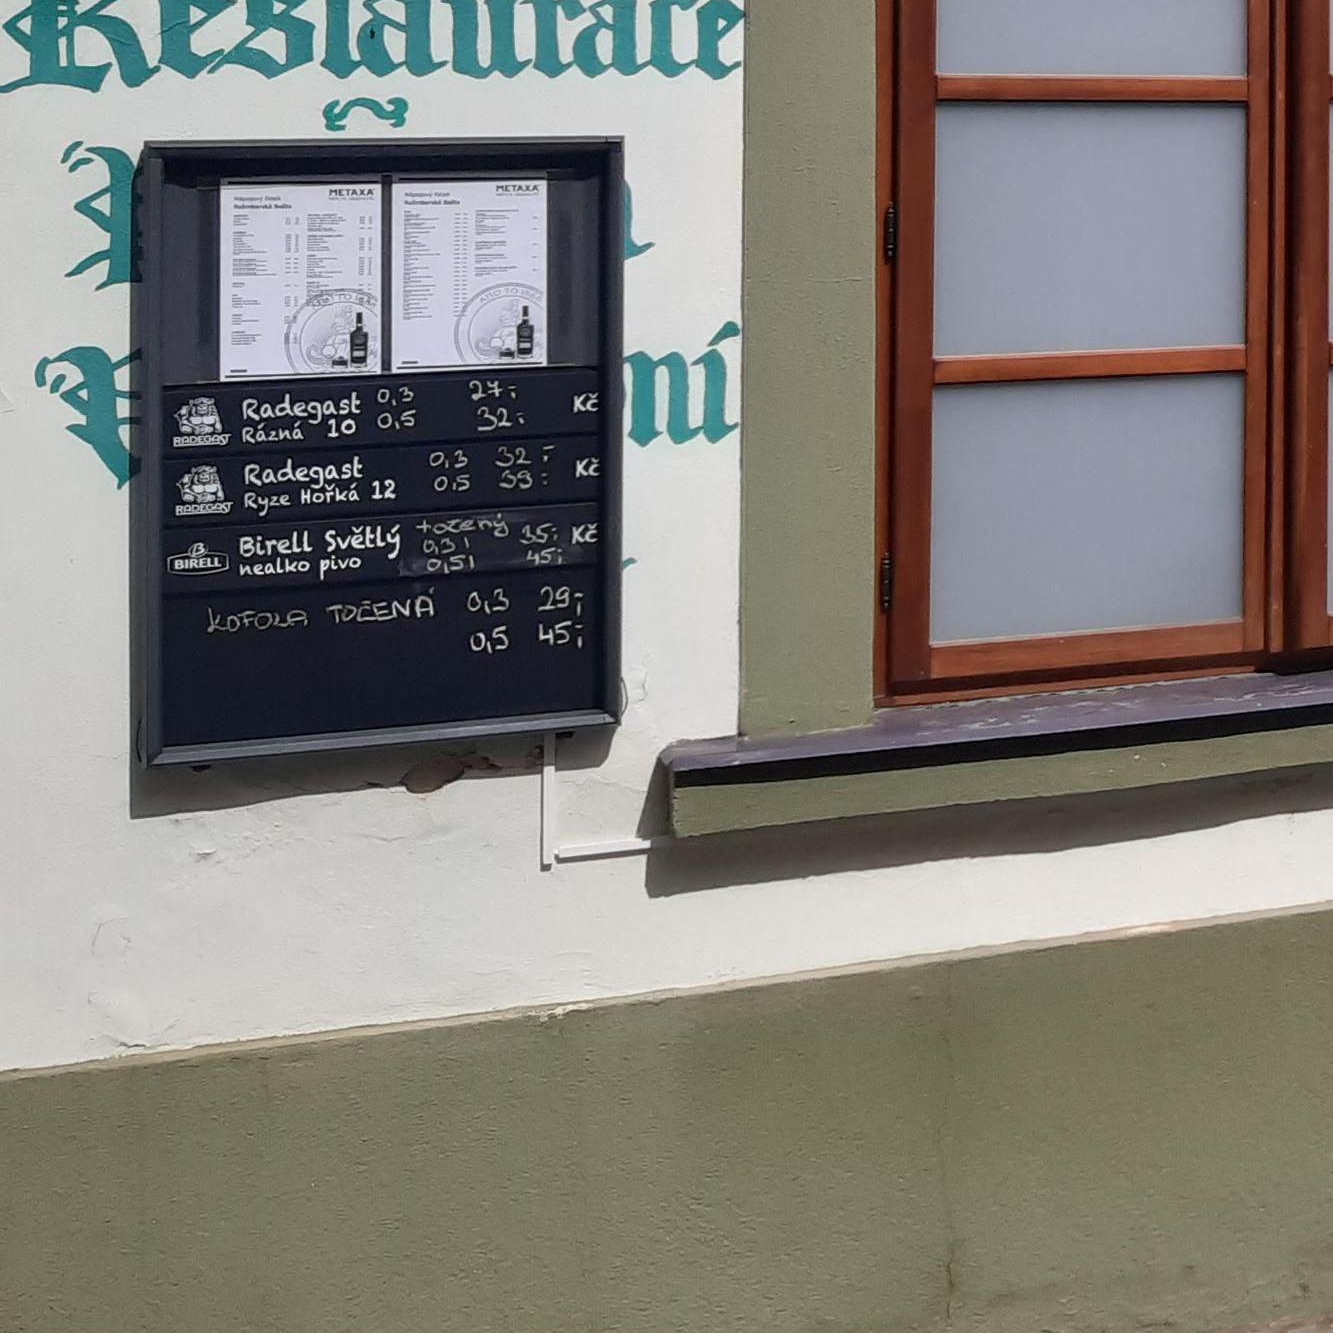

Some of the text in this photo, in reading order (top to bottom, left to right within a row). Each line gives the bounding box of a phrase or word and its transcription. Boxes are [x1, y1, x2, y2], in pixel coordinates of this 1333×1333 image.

[328, 188, 375, 197] METAXA
[496, 184, 539, 193] METAXA
[242, 392, 361, 424] Radegast
[377, 387, 415, 406] 0,3
[573, 392, 599, 413] Kč
[173, 434, 232, 447] RADEGAST
[242, 421, 304, 443] Rázná
[327, 418, 356, 438] 10
[377, 410, 416, 429] 0,5
[244, 456, 363, 488] Radegast
[429, 450, 468, 468] 0,3
[575, 458, 600, 477] Kč
[175, 501, 234, 515] RADEGAST
[244, 492, 291, 517] Ryze
[301, 481, 360, 504] Hořká
[371, 479, 396, 499] 12
[434, 473, 470, 491] 0,5
[239, 530, 313, 557] Birell
[325, 524, 401, 559] Světlý
[571, 523, 598, 544] Kč
[174, 556, 222, 570] BIRELL
[240, 556, 310, 576] nealko
[320, 555, 362, 580] pivo
[207, 607, 309, 633] KOFOLA
[326, 587, 435, 623] TOČENÁ
[467, 588, 509, 614] 0,3
[470, 625, 509, 653] 0,5
